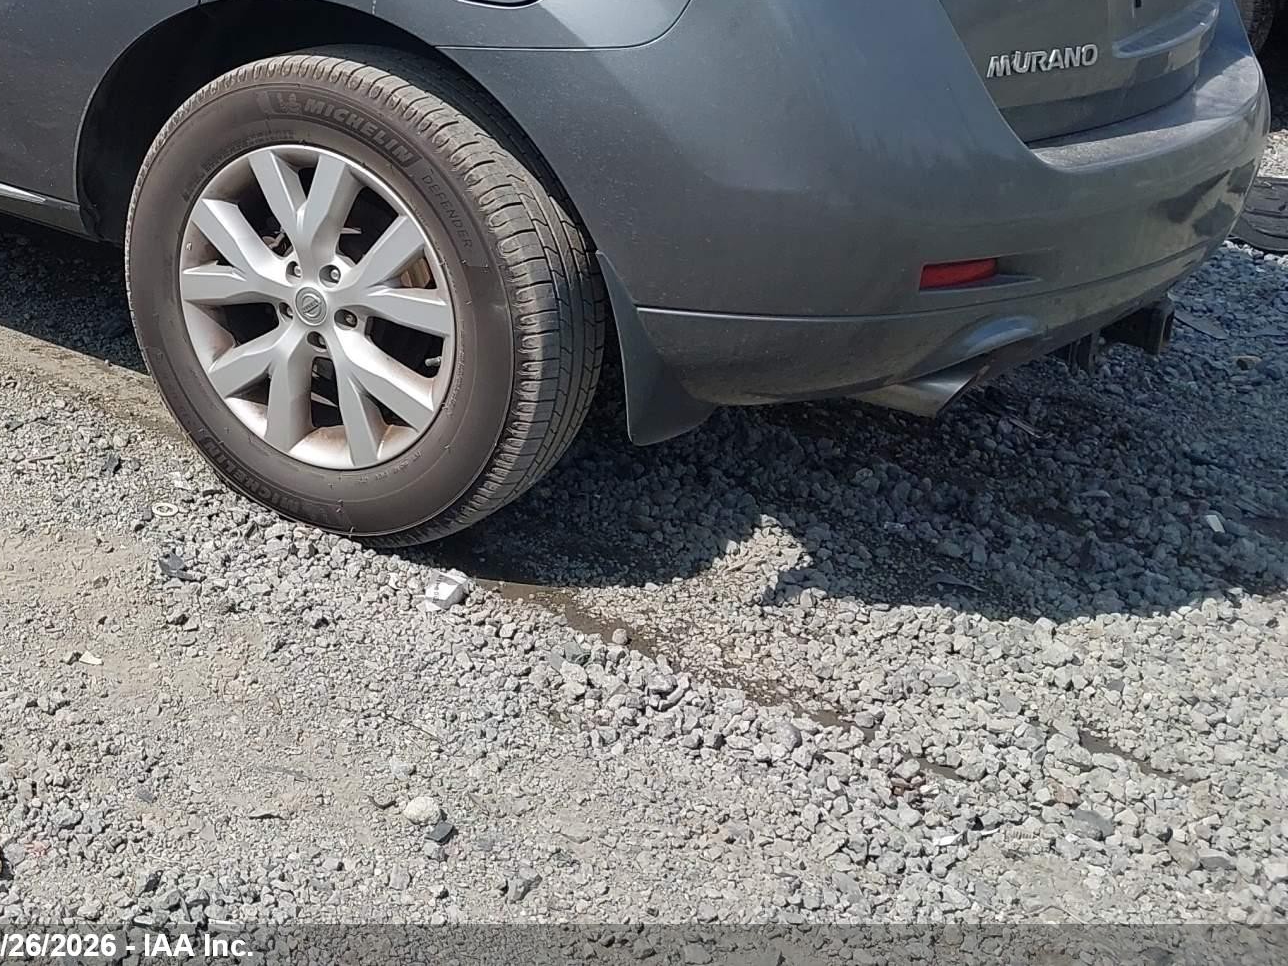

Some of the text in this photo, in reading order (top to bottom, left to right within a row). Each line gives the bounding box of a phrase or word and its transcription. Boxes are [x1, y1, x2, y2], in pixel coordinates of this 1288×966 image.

[986, 43, 1099, 79] MURANO
[303, 97, 414, 163] MICHELIN
[421, 174, 473, 248] DEFENDER
